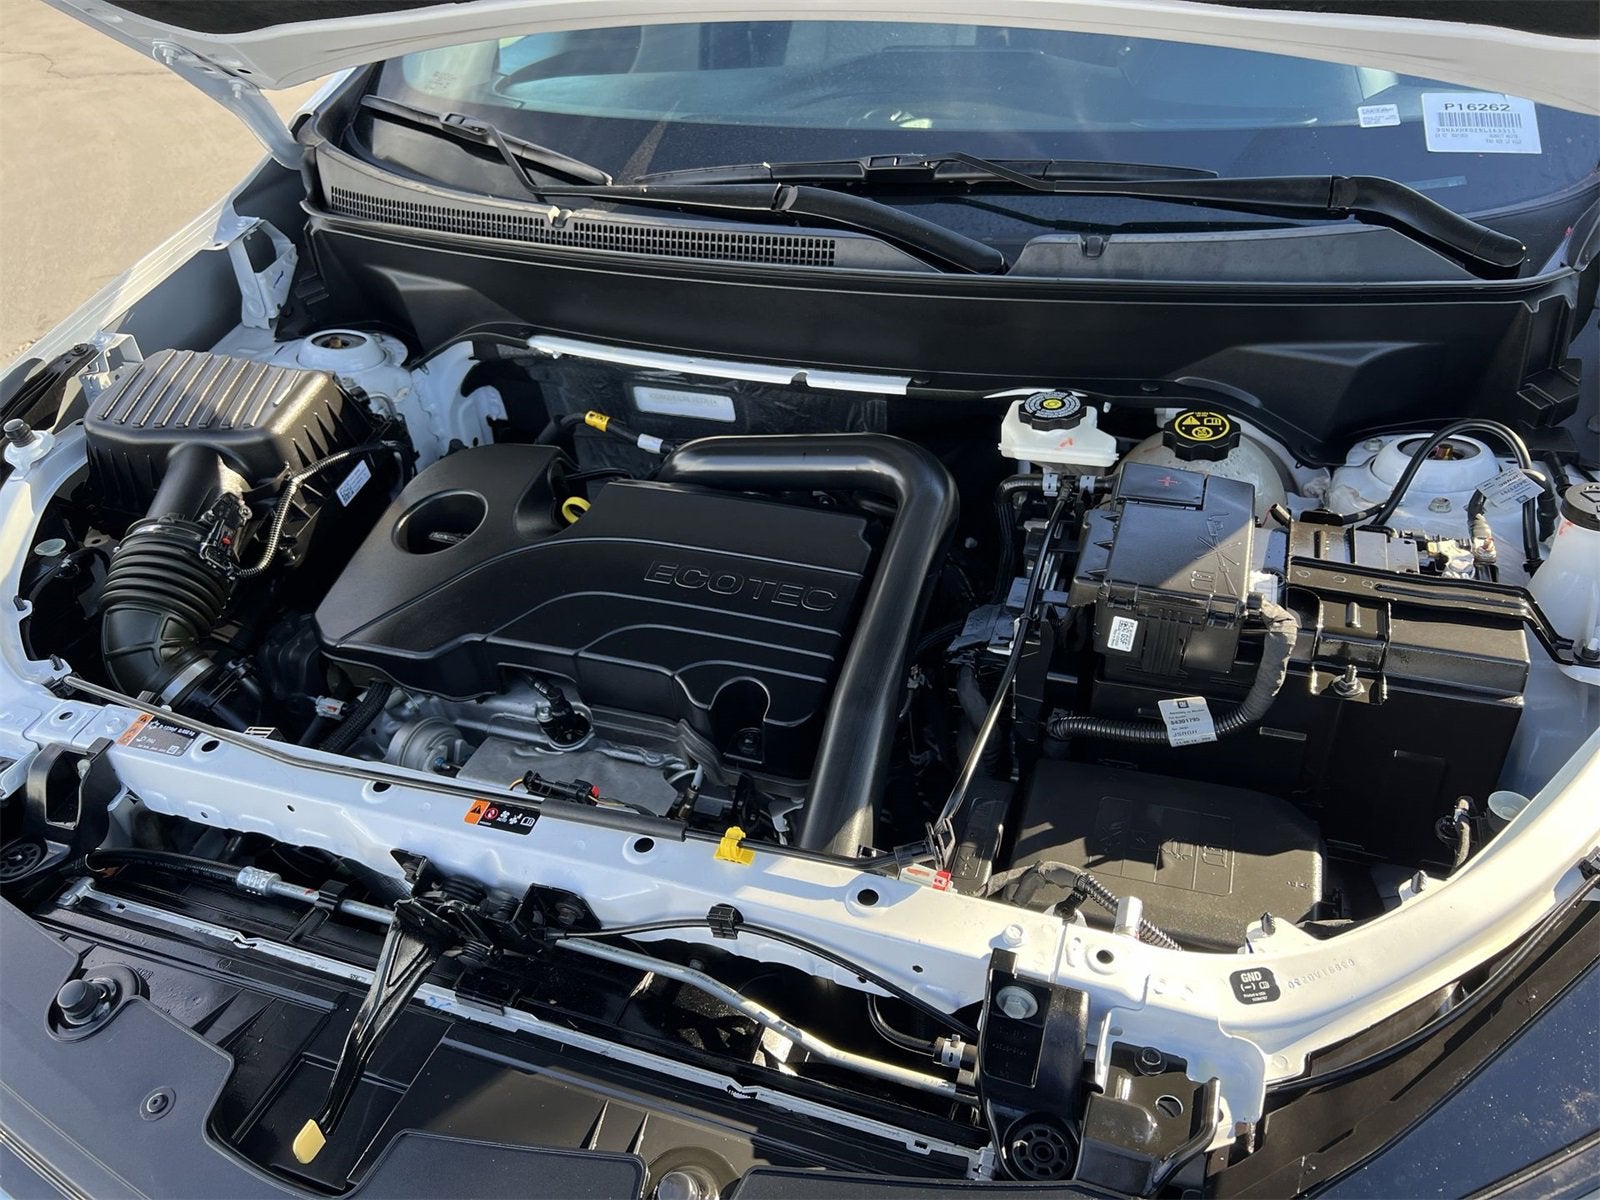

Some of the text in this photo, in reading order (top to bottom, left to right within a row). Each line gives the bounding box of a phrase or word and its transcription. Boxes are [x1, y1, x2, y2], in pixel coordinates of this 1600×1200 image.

[1444, 103, 1511, 111] P16262
[644, 560, 838, 611] ECOTEC
[1240, 971, 1262, 983] GND
